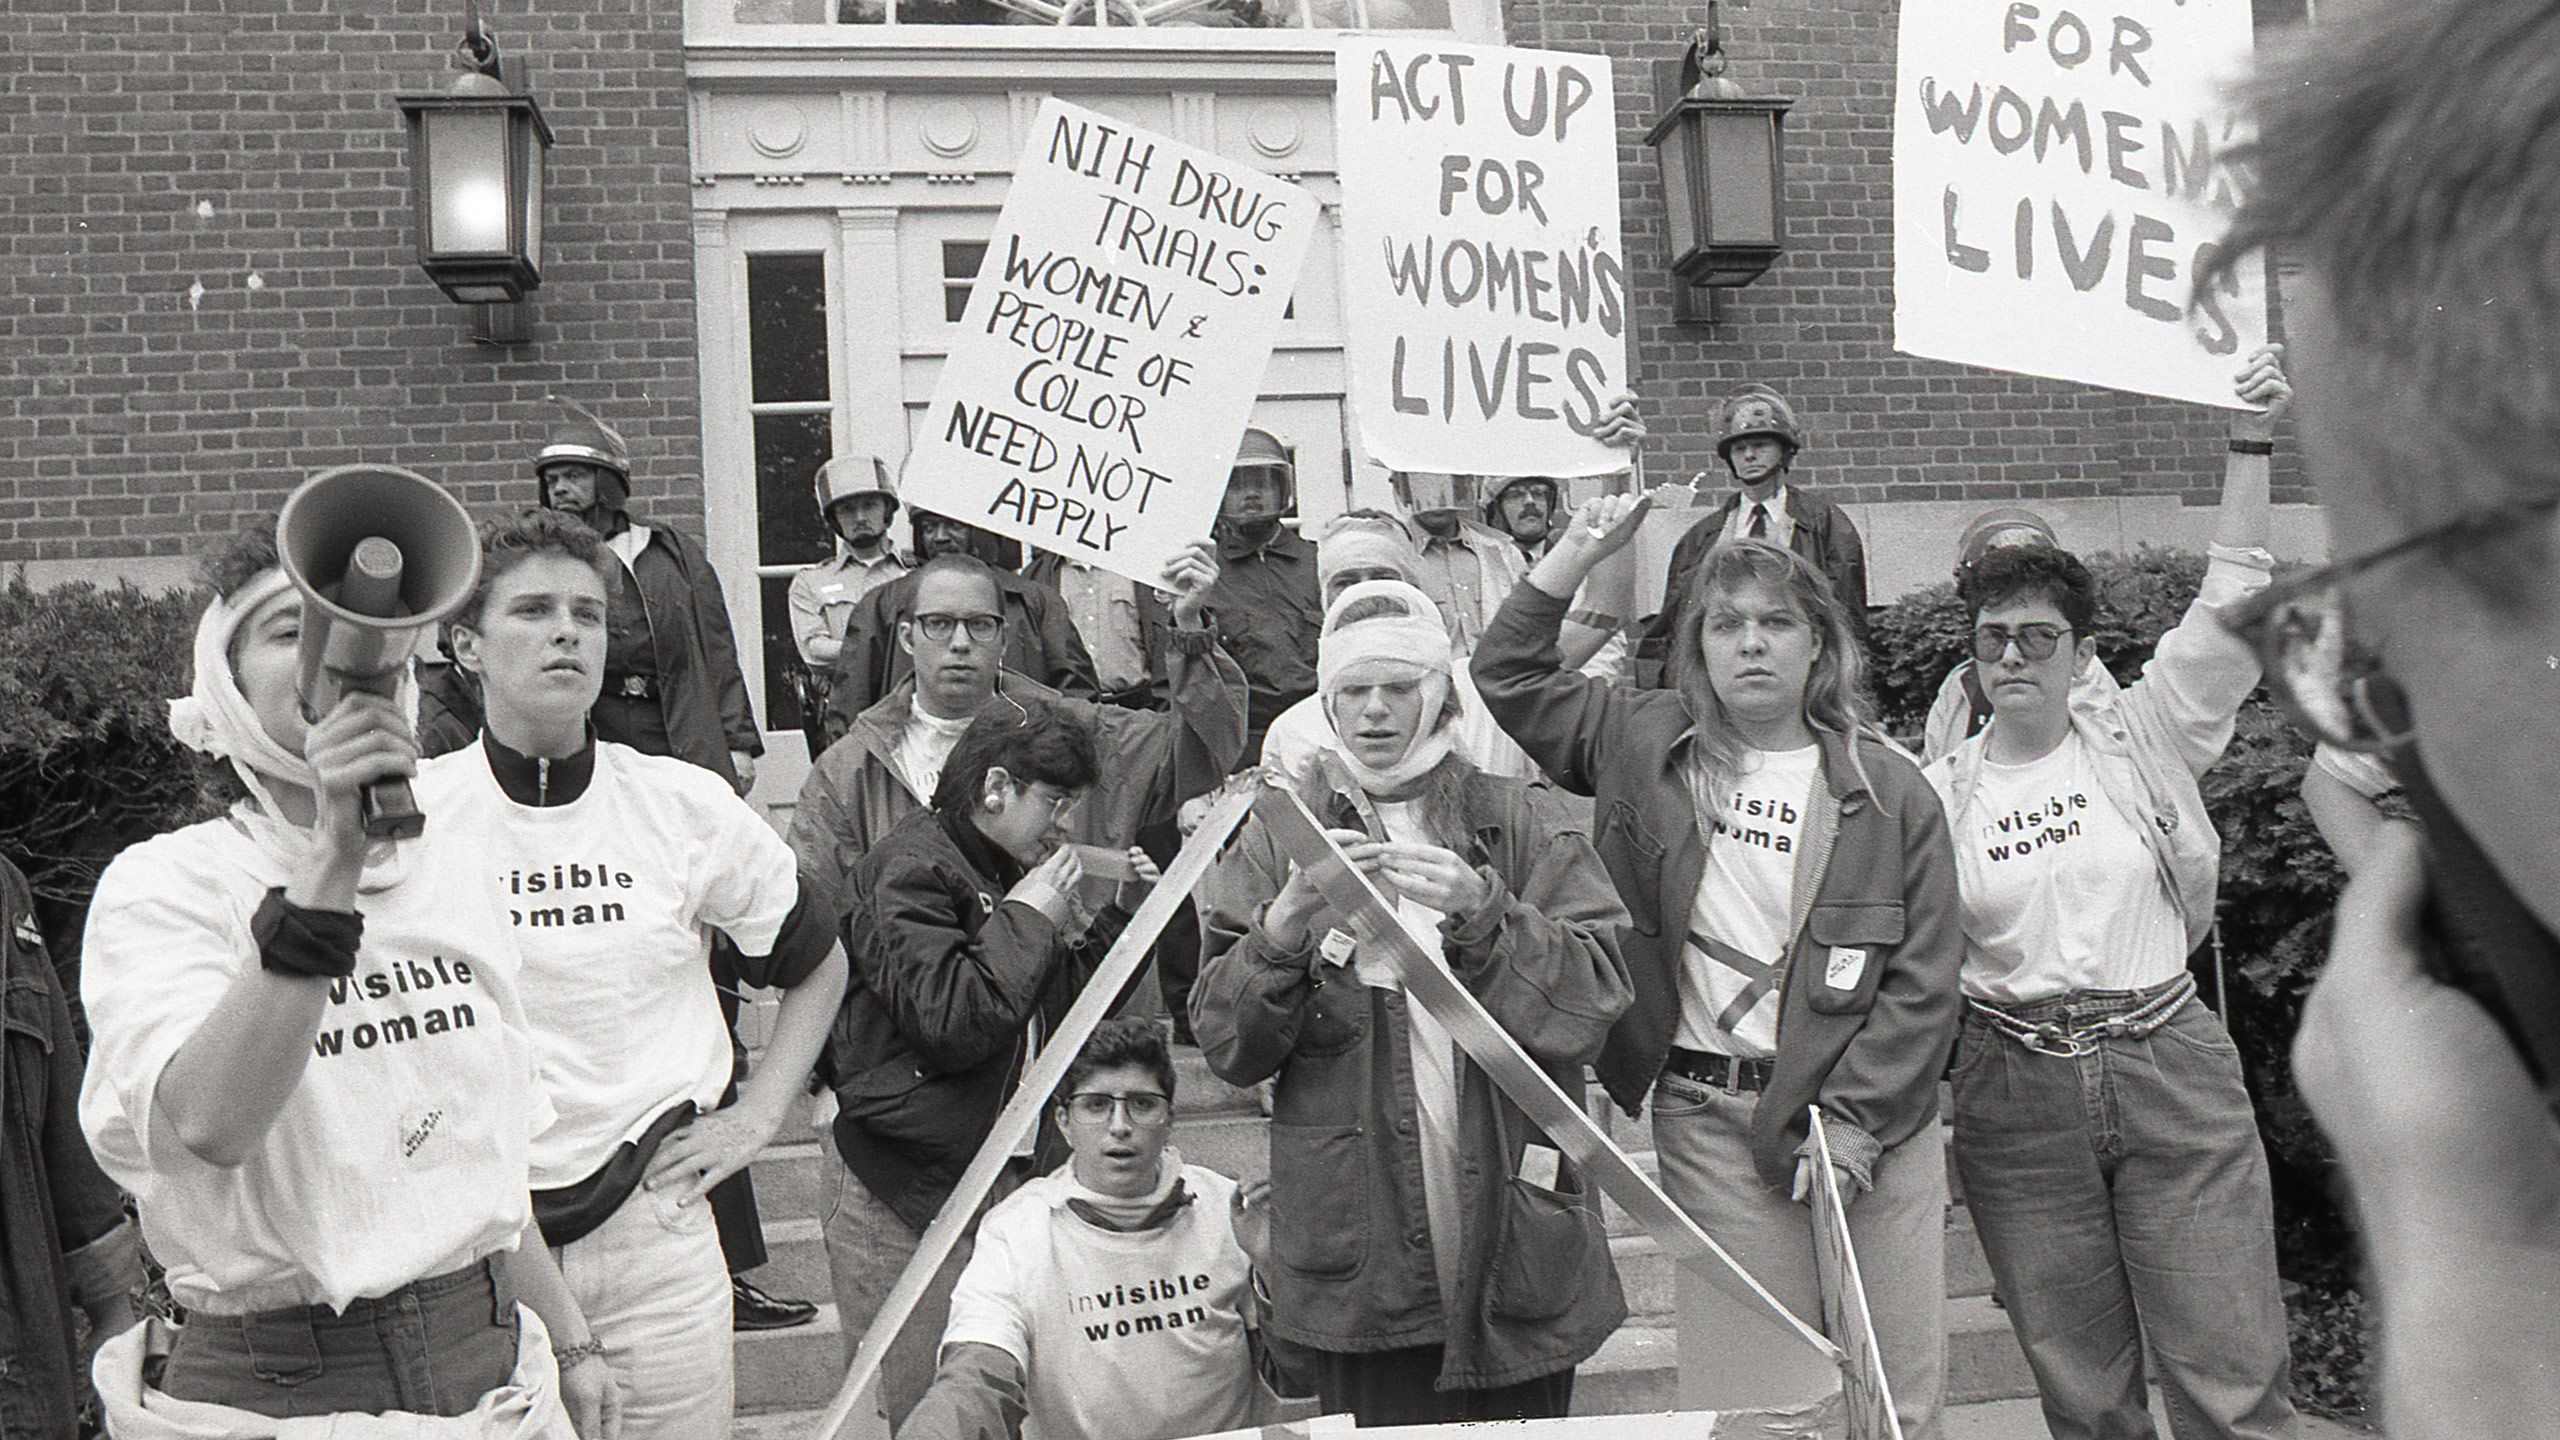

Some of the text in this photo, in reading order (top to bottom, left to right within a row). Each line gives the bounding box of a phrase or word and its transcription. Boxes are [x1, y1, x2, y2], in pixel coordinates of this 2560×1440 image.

[2004, 3, 2153, 88] FOR
[1371, 49, 1593, 143] ACT UP
[1048, 115, 1287, 242] NIH DRUG
[1439, 155, 1548, 227] FOR
[1003, 234, 1208, 339] WOMEN &
[1095, 194, 1267, 297] TRIALS:
[1383, 226, 1624, 338] WOMEN'S
[1943, 183, 2240, 356] LIVES
[986, 291, 1194, 396] PEOPLE OF
[1392, 335, 1606, 437] LIVES
[1014, 359, 1147, 454] COLOR
[945, 400, 1173, 514] NEED NOT
[988, 478, 1128, 552] APPLY
[498, 863, 634, 895] isible
[1987, 819, 2081, 862] woman
[314, 1002, 476, 1057] woman
[1067, 1273, 1211, 1315] invisible
[1084, 1305, 1207, 1342] woman
